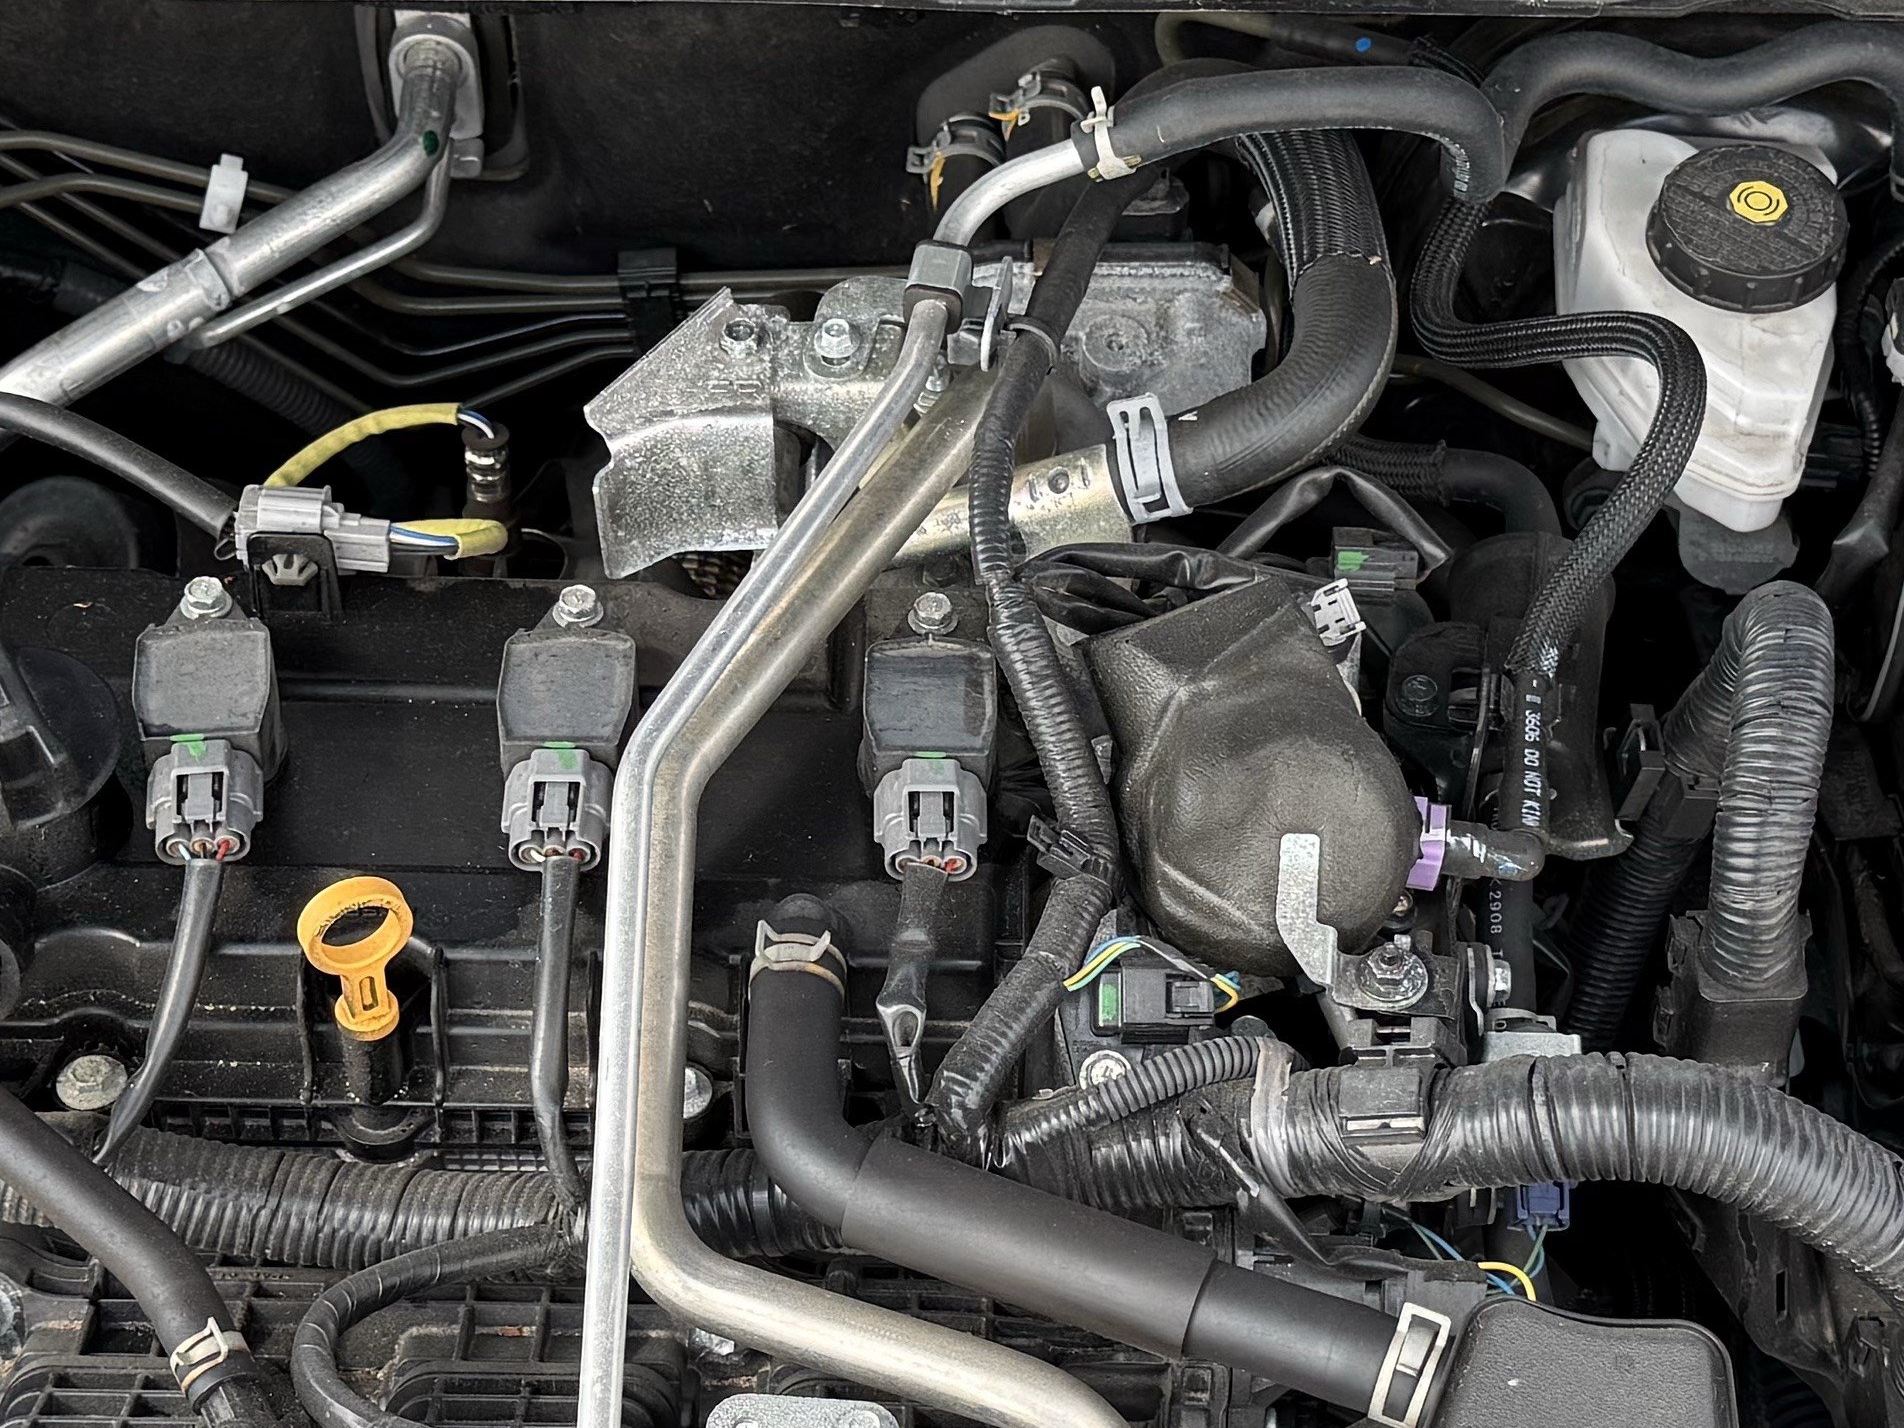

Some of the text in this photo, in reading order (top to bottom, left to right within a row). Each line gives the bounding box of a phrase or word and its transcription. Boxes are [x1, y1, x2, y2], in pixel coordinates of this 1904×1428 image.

[1523, 709, 1541, 741] 3606
[1523, 747, 1539, 766] DO
[1523, 770, 1541, 797] NOT
[1521, 798, 1540, 827] KIN
